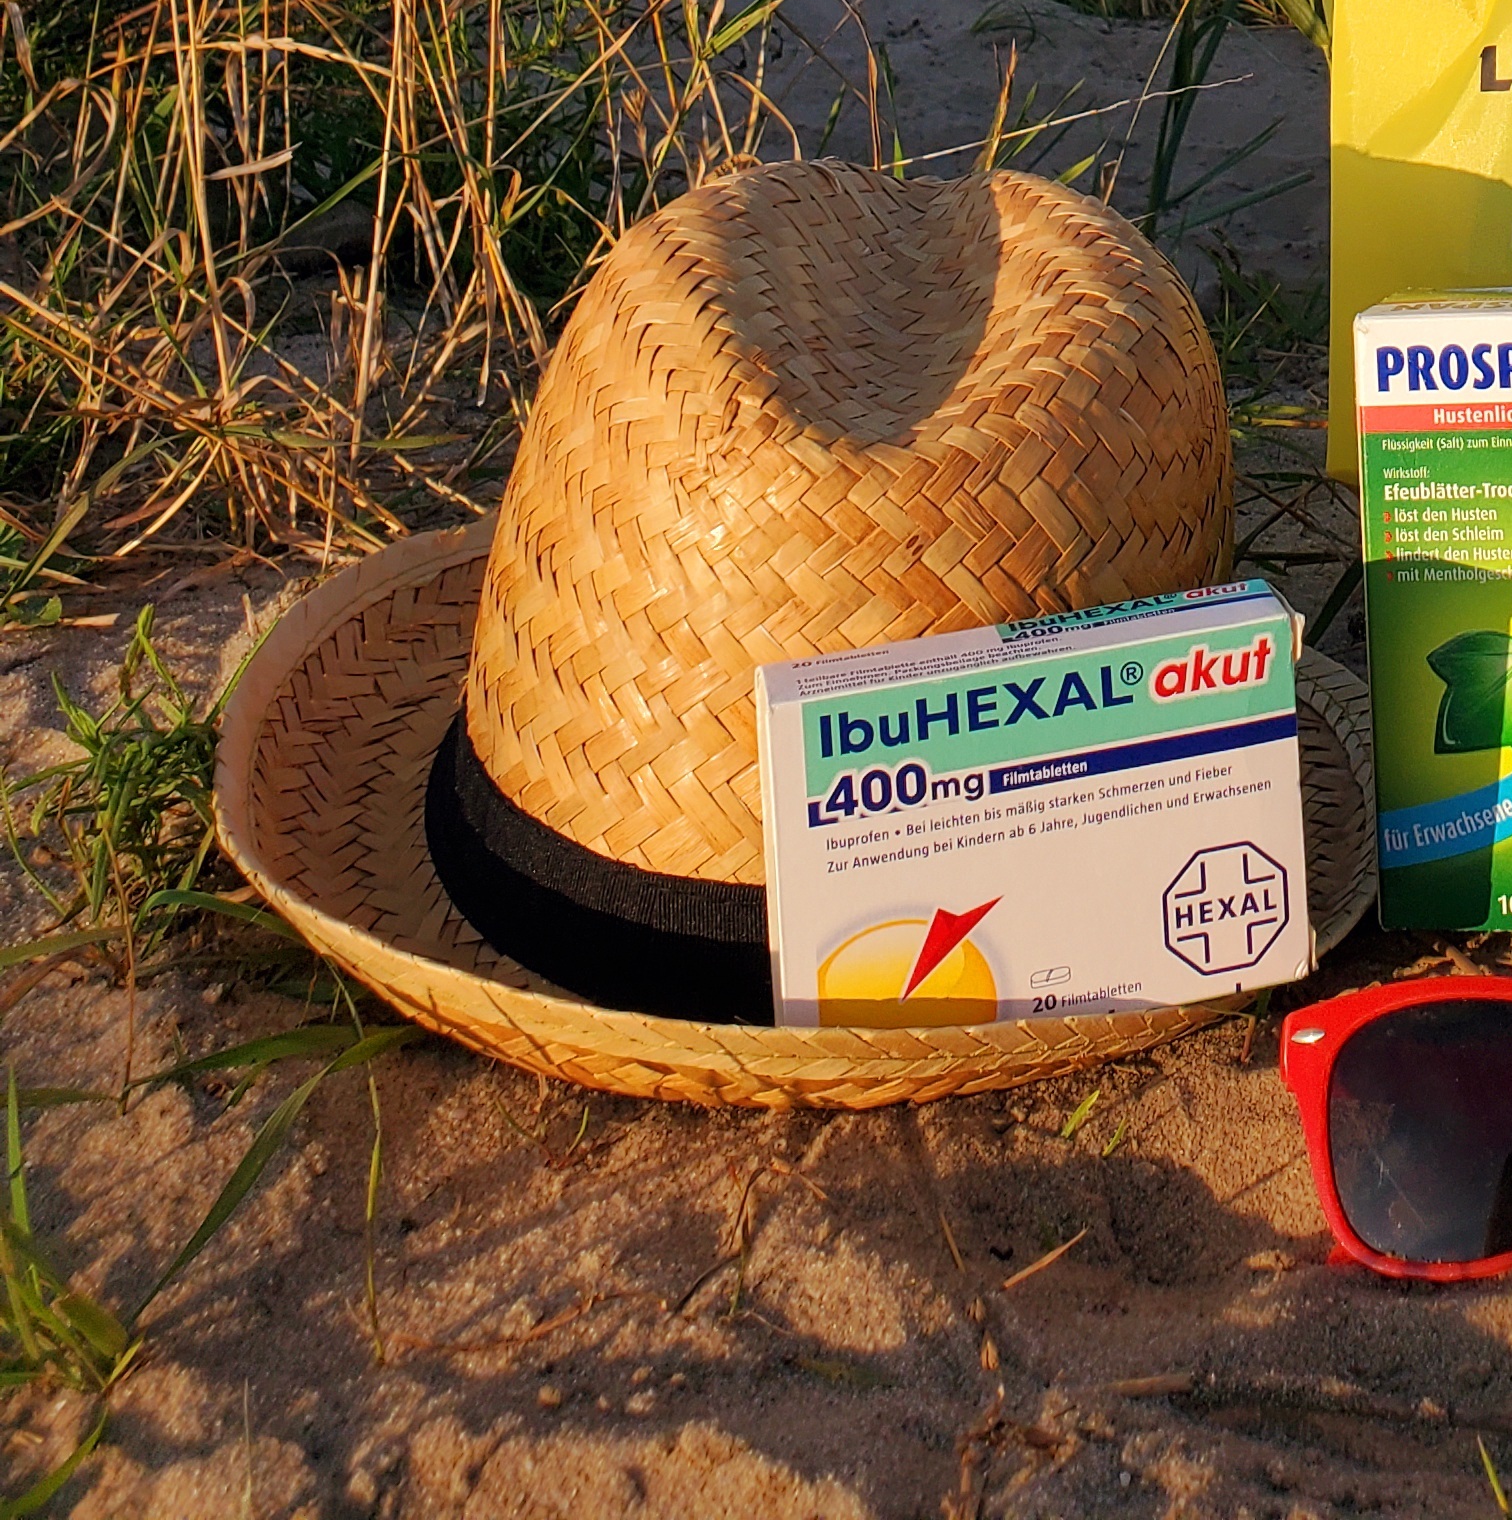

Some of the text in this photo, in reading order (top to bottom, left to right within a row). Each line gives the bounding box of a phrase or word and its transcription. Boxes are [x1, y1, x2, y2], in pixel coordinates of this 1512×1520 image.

[1382, 437, 1433, 453] Flüssigkeit
[1436, 437, 1464, 452] (Saft)
[1466, 440, 1489, 449] zum
[1382, 467, 1431, 479] Wirkstoff:
[1394, 507, 1498, 523] löst den Husten
[1395, 527, 1504, 542] löst den Schleim
[1396, 547, 1440, 562] lindert
[1444, 547, 1469, 561] den
[1397, 569, 1421, 582] mit
[1185, 582, 1248, 600] akut
[791, 649, 890, 669] 20 Filmtabletten
[960, 650, 984, 659] 400
[1153, 638, 1275, 698] akut
[1003, 759, 1088, 787] Filmtabletten
[826, 764, 1233, 851] Ibuprofen Bei leichten bis mäßig starken Schmerzen und Fieber
[827, 779, 1272, 873] Zur Anwendung bei Kindern ab 6 Jahre, Jugendlichen und Erwachsenen
[1383, 830, 1410, 852] für
[1175, 888, 1278, 929] HEXAL
[1032, 981, 1142, 1013] 20 Filmtabletten
